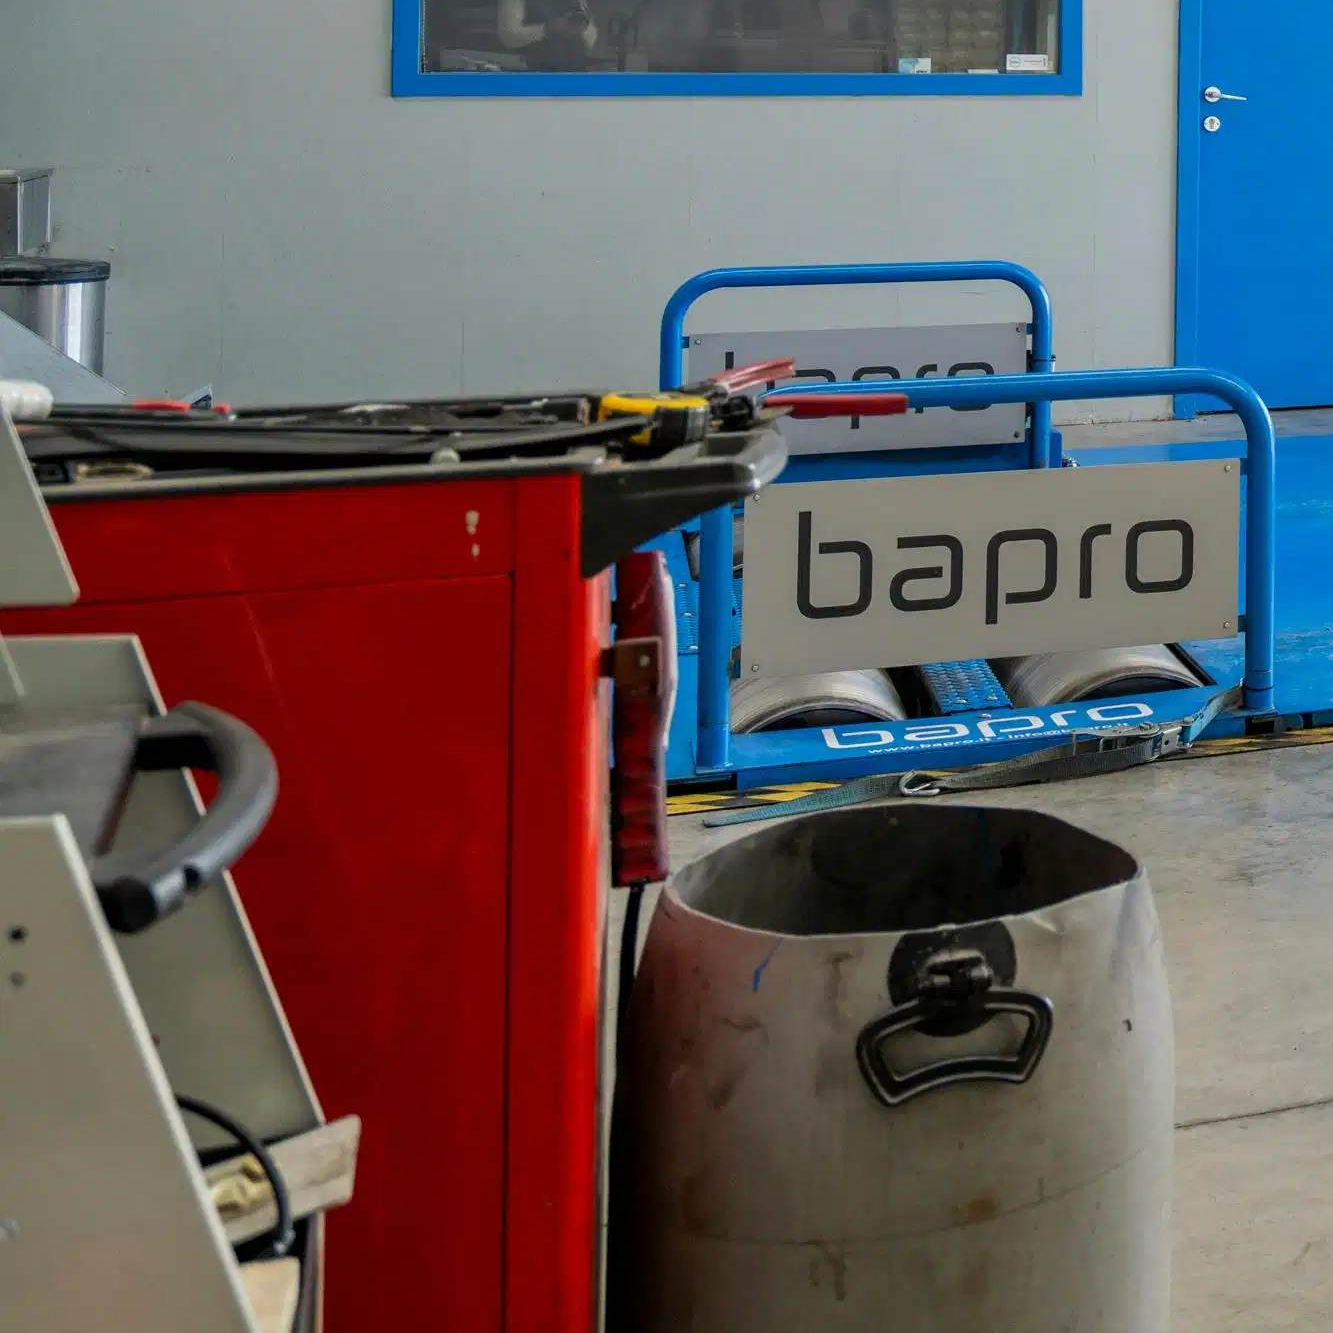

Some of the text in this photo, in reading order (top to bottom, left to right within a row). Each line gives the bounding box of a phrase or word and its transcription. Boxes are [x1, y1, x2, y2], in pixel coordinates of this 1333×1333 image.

[796, 510, 1195, 626] bapro
[821, 702, 1154, 750] bapro
[867, 737, 998, 755] www.bapro.it
